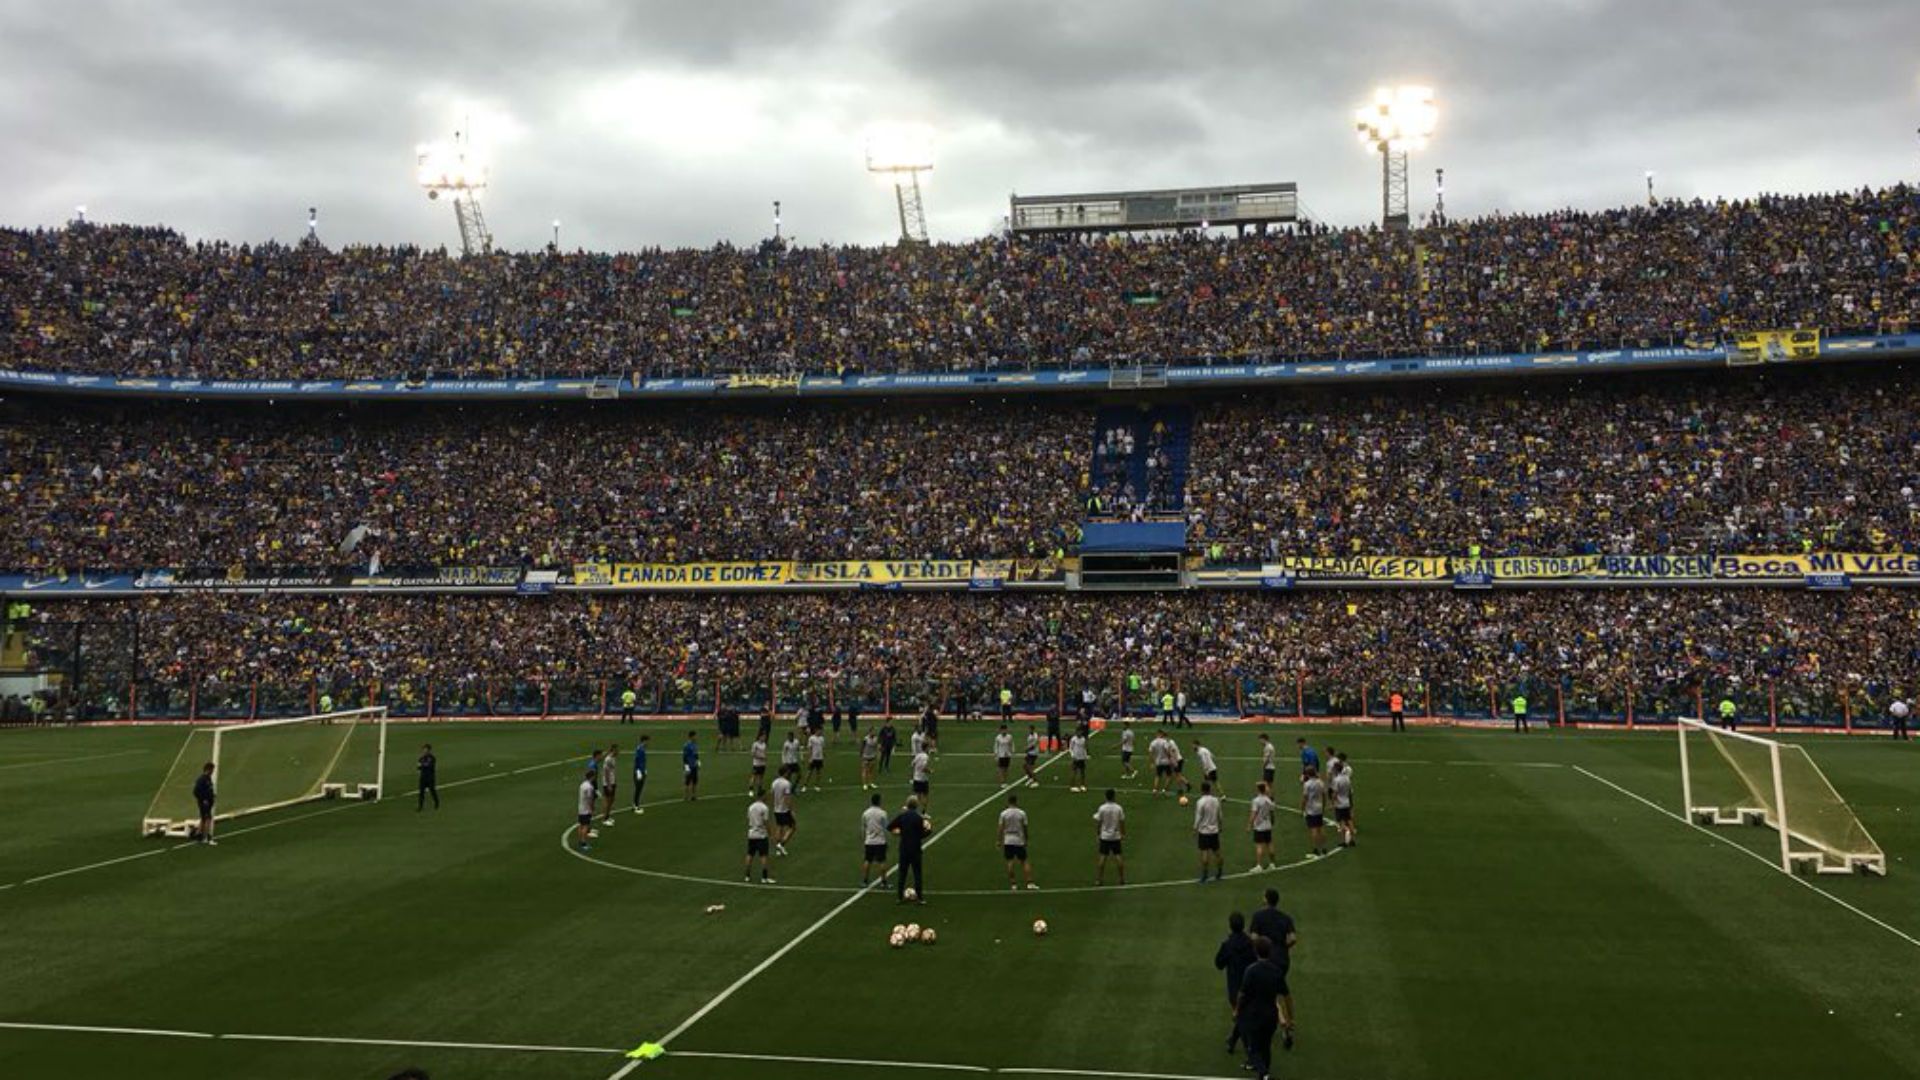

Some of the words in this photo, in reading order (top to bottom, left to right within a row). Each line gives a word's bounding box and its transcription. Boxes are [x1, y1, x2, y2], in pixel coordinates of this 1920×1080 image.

[814, 563, 872, 577] ISLA
[886, 562, 970, 577] VERDE
[1371, 558, 1437, 577] GERLI
[1608, 557, 1712, 575] BRANDSEN
[1719, 557, 1800, 574] Boca
[1810, 552, 1844, 571] Mi
[1852, 553, 1920, 571] Vida
[692, 566, 715, 581] DE
[720, 565, 781, 581] GOMEZ
